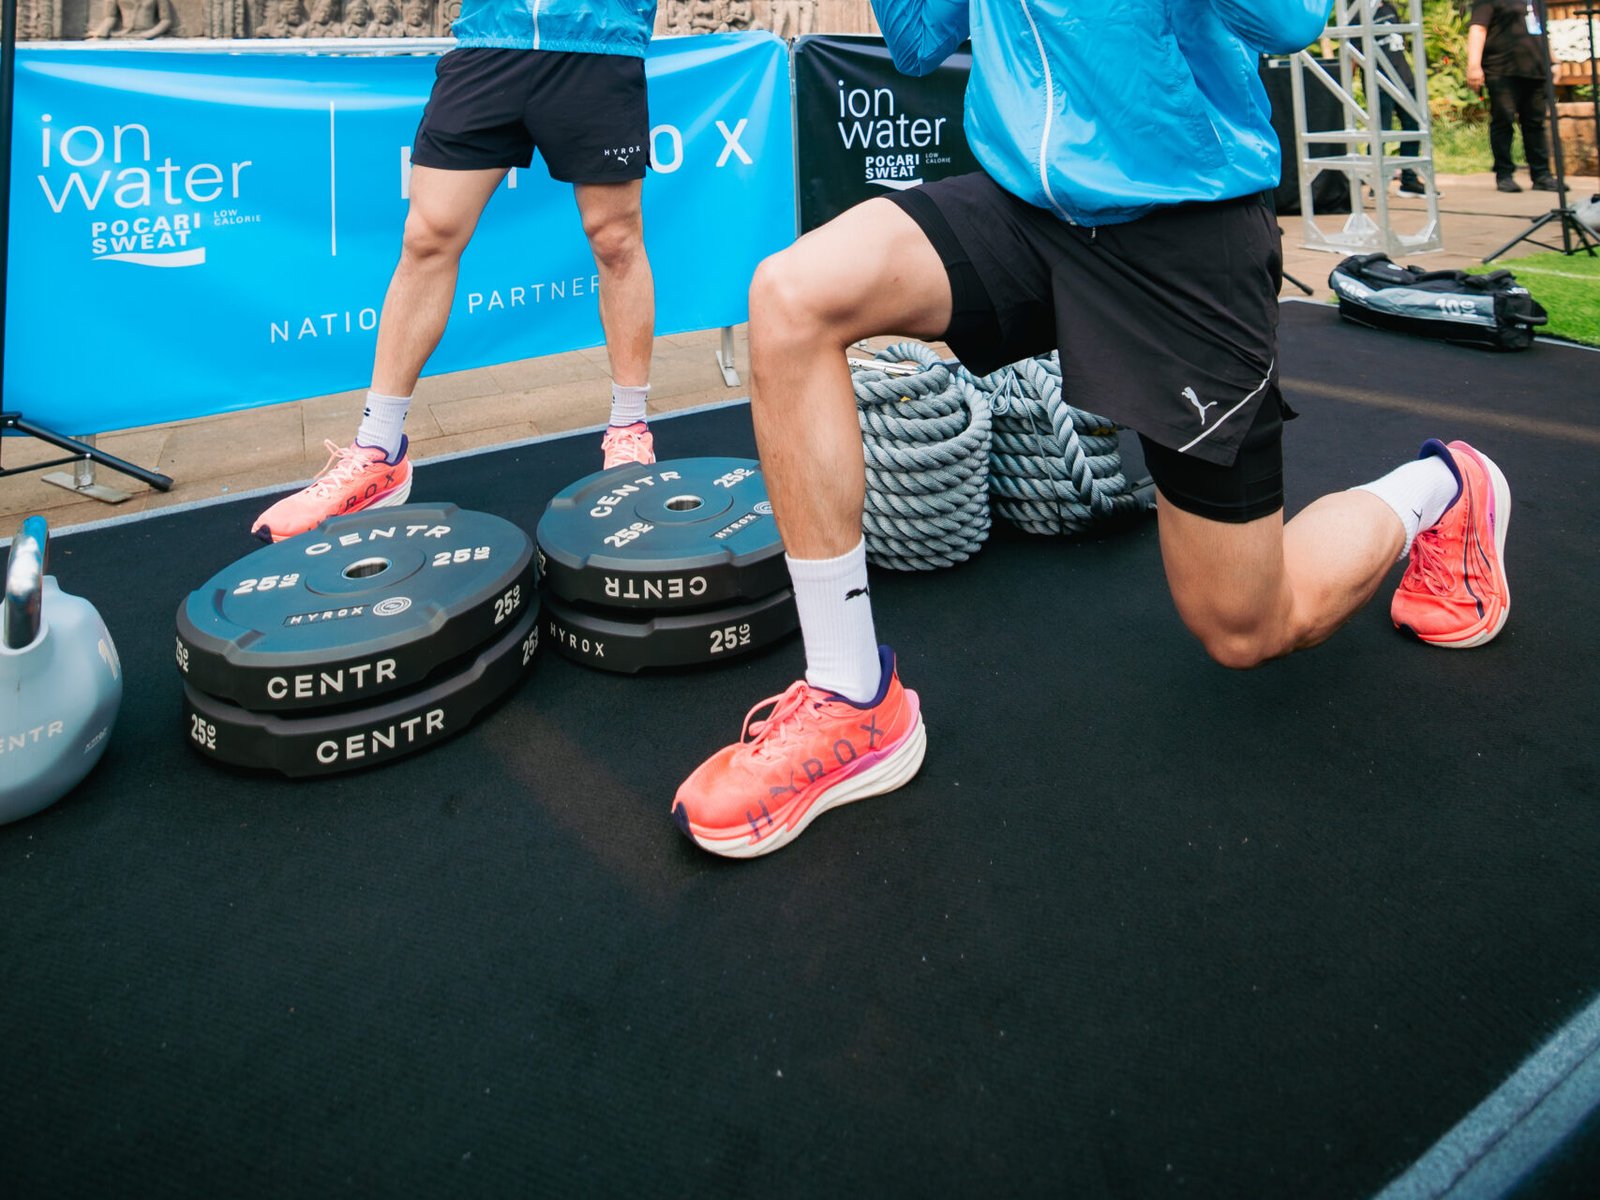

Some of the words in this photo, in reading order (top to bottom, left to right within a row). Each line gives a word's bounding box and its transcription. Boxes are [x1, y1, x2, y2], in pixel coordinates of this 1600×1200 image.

[838, 79, 894, 118] ion
[41, 114, 151, 168] ion
[837, 113, 946, 150] water
[604, 145, 641, 156] HYROX
[865, 153, 919, 168] POCARI
[37, 157, 252, 213] water
[865, 165, 915, 179] SWEAT
[91, 212, 200, 238] POCARI
[213, 209, 238, 219] LOW
[213, 214, 262, 227] CALORIE
[92, 230, 191, 254] SWEAT
[270, 307, 376, 344] NATIO
[590, 470, 682, 518] CENTR
[305, 525, 451, 556] CENTR
[715, 514, 758, 540] HYROX
[604, 576, 708, 599] CENTR
[290, 605, 364, 625] HYROX
[550, 621, 605, 657] HYROX
[267, 658, 397, 699] CENTR
[316, 707, 445, 764] CENTR
[746, 714, 884, 840] HYROX
